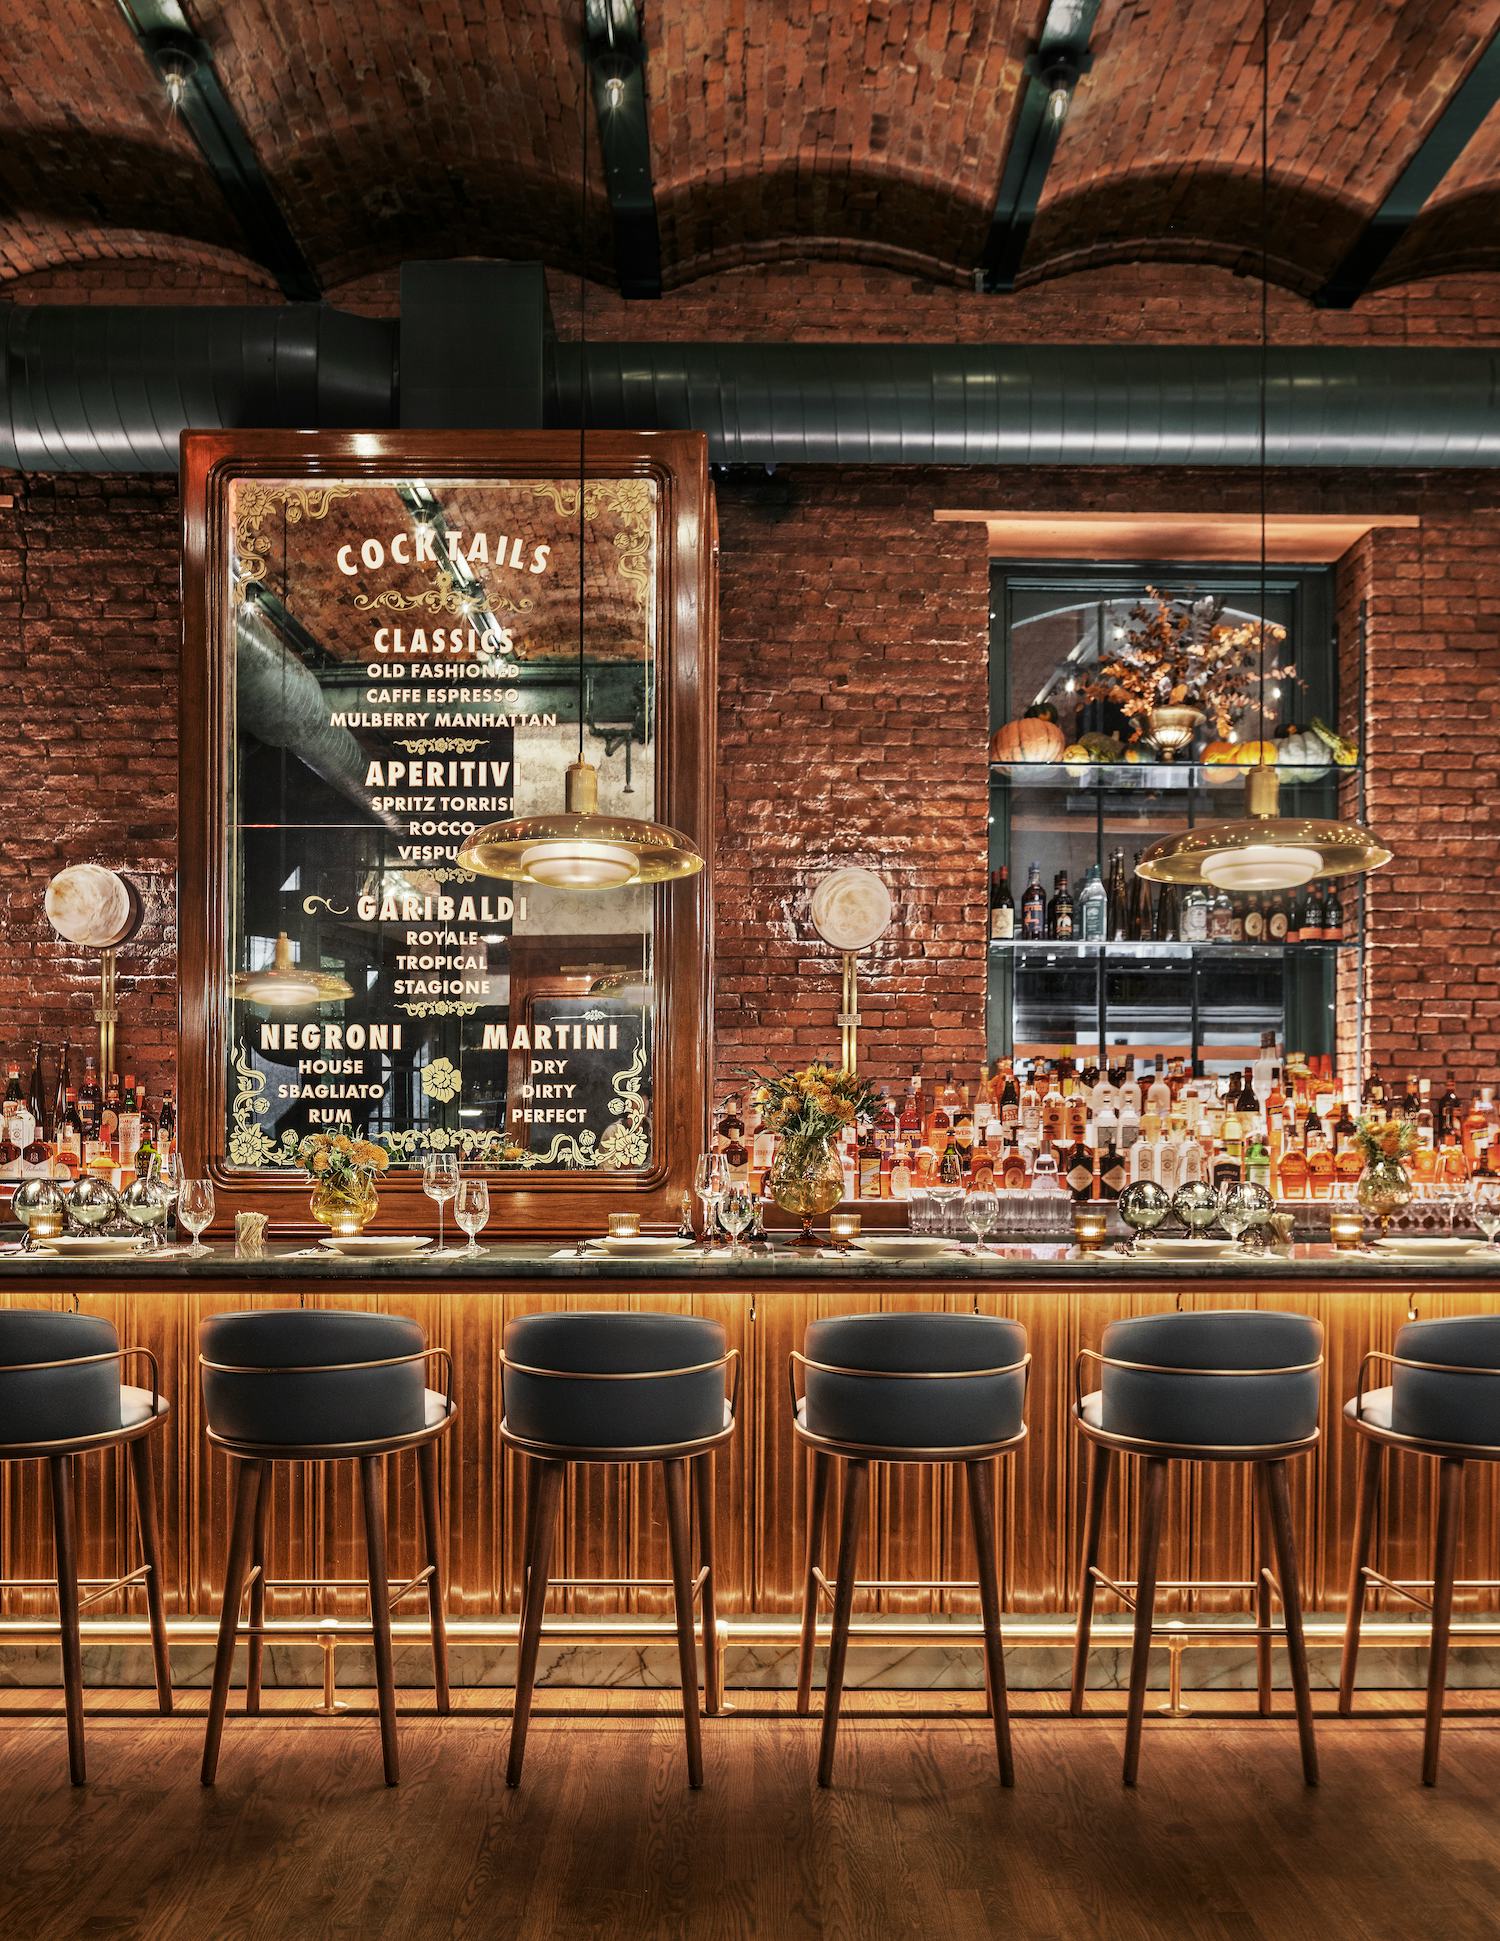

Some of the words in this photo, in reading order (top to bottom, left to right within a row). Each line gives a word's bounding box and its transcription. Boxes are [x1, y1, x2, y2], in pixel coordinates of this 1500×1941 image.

[336, 530, 551, 576] COCKTAILS
[373, 628, 514, 654] CLASSICS
[366, 663, 405, 678] OLD
[366, 688, 421, 703] CAFFE
[427, 688, 520, 703] ESPRESSO
[329, 712, 430, 727] MULBERRY
[434, 712, 557, 727] MANHATTAN
[364, 760, 521, 787] APERITIVI
[371, 796, 436, 811] SPRITZ
[440, 796, 514, 811] TORRISI
[409, 820, 476, 836] ROCCO
[397, 845, 459, 860] VESPU
[357, 895, 528, 921] GARIBALDI
[406, 931, 478, 945] ROYALE
[396, 955, 488, 970] TROPICAL
[393, 979, 491, 995] STAGIONE
[260, 1023, 402, 1050] NEGRONI
[482, 1023, 618, 1050] MARTINI
[298, 1059, 364, 1075] HOUSE
[530, 1059, 568, 1074] DRY
[278, 1084, 384, 1099] SBAGLIATO
[522, 1084, 576, 1099] DIRTY
[308, 1108, 352, 1124] RUM
[511, 1108, 587, 1123] PERFECT
